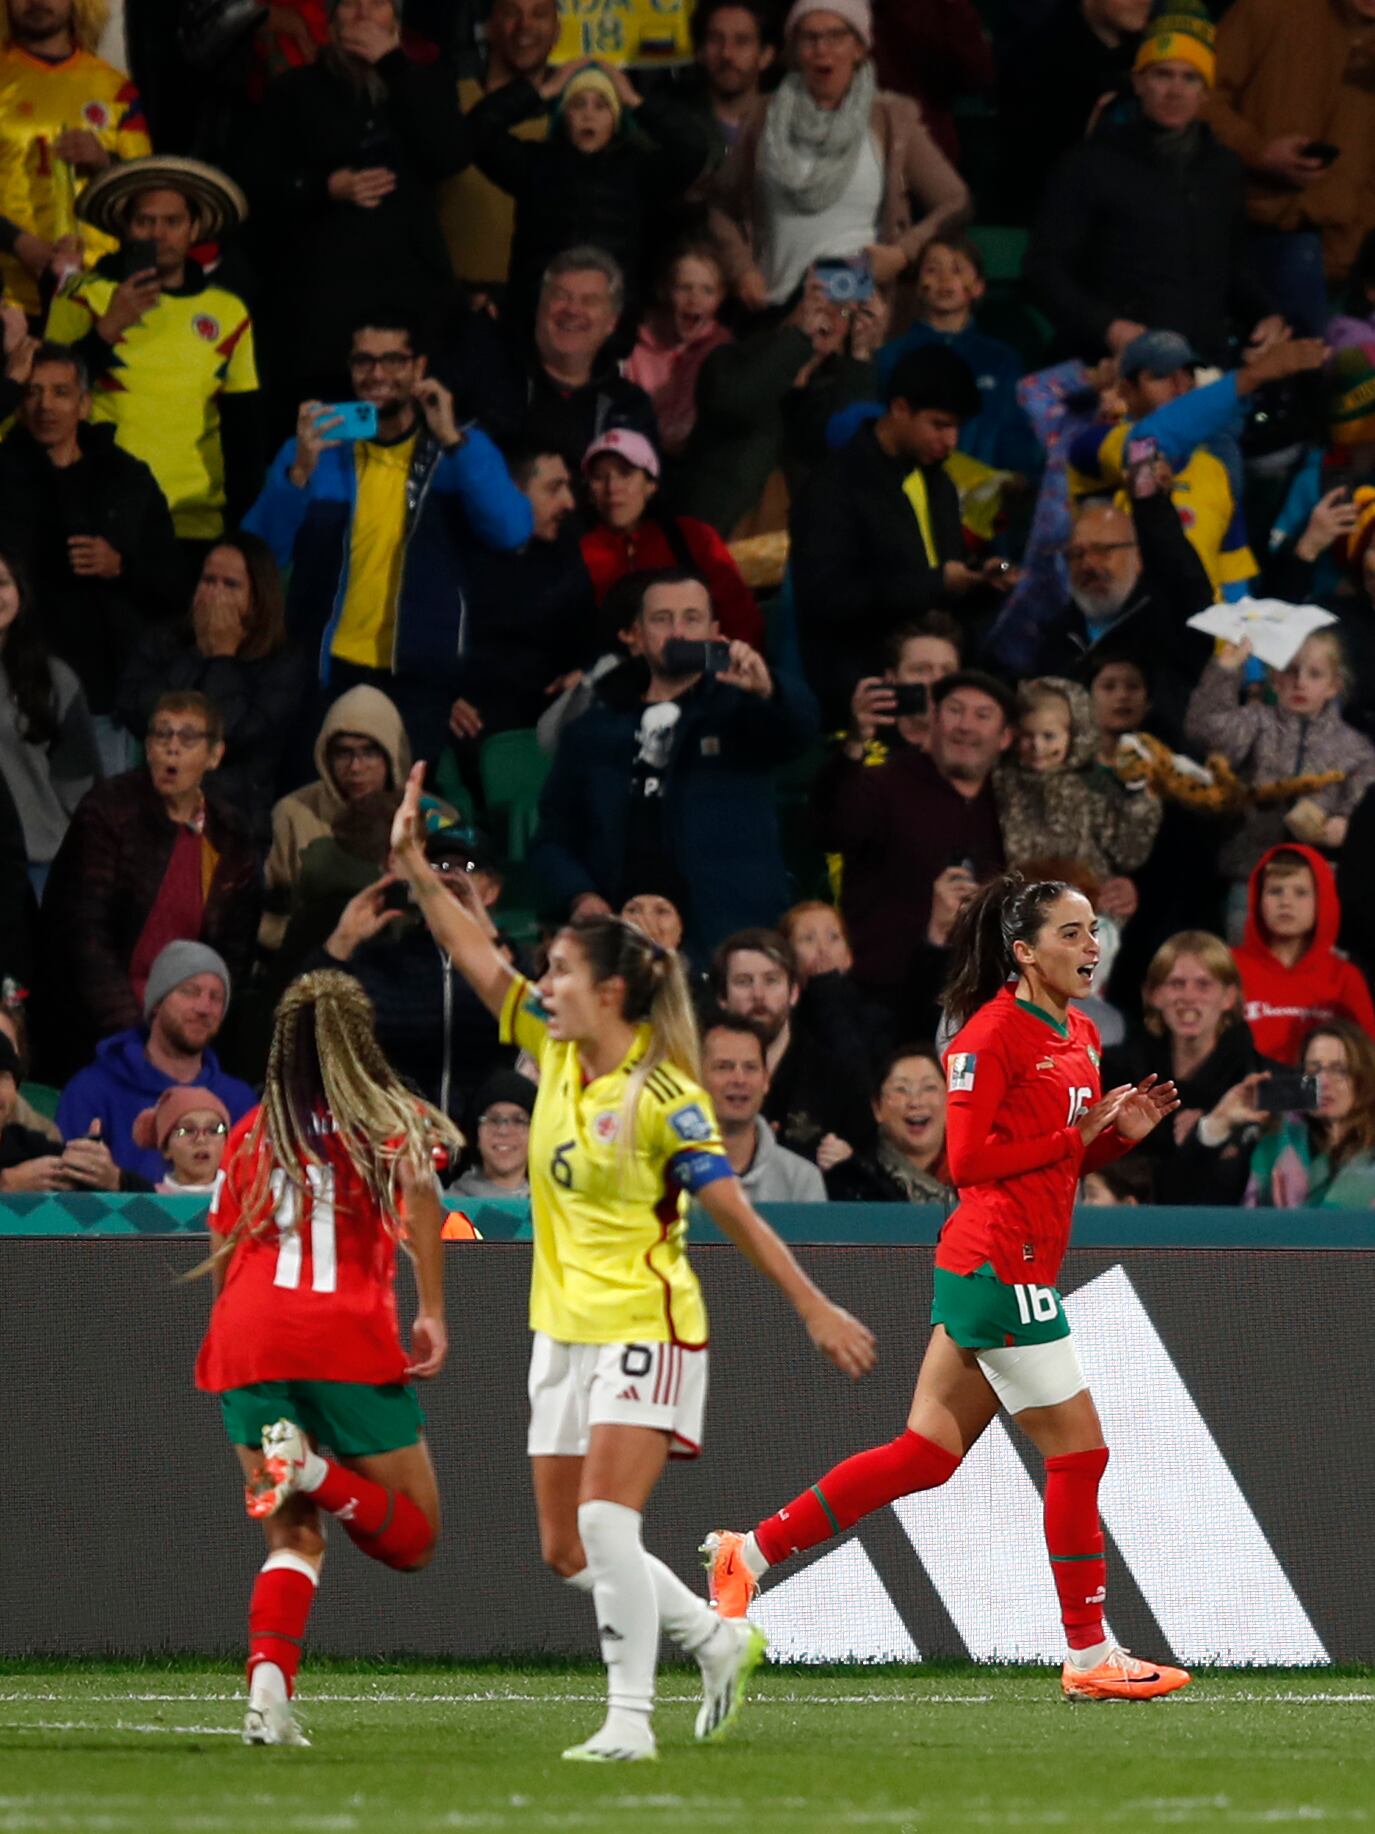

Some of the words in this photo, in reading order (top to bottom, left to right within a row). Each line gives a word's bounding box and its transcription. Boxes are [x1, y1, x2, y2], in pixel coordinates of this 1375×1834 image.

[581, 19, 624, 54] 18
[550, 1138, 576, 1191] 6
[268, 1163, 337, 1293] 11
[1013, 1283, 1058, 1325] 16
